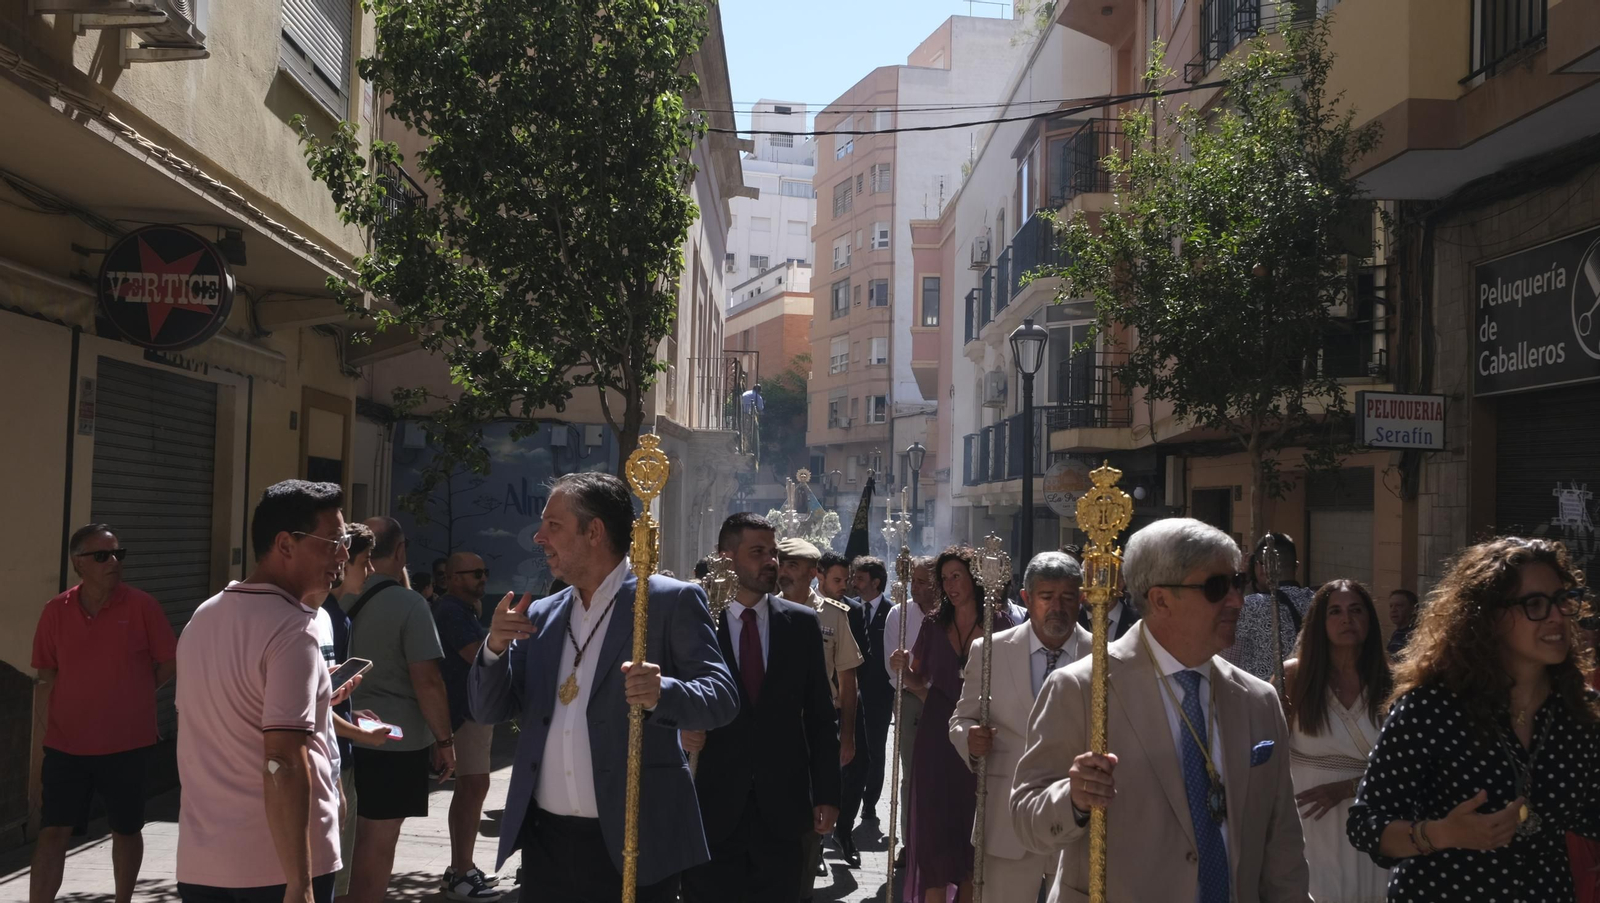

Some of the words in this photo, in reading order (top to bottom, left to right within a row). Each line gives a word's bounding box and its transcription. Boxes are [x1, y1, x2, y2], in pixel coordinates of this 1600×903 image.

[107, 271, 219, 305] VERTICE
[1480, 263, 1566, 309] Peluquería
[1480, 315, 1498, 342] de
[1479, 341, 1566, 376] Caballeros
[1367, 399, 1443, 421] PELUQUERIA
[1375, 427, 1432, 445] Serafín
[503, 477, 546, 517] Alm
